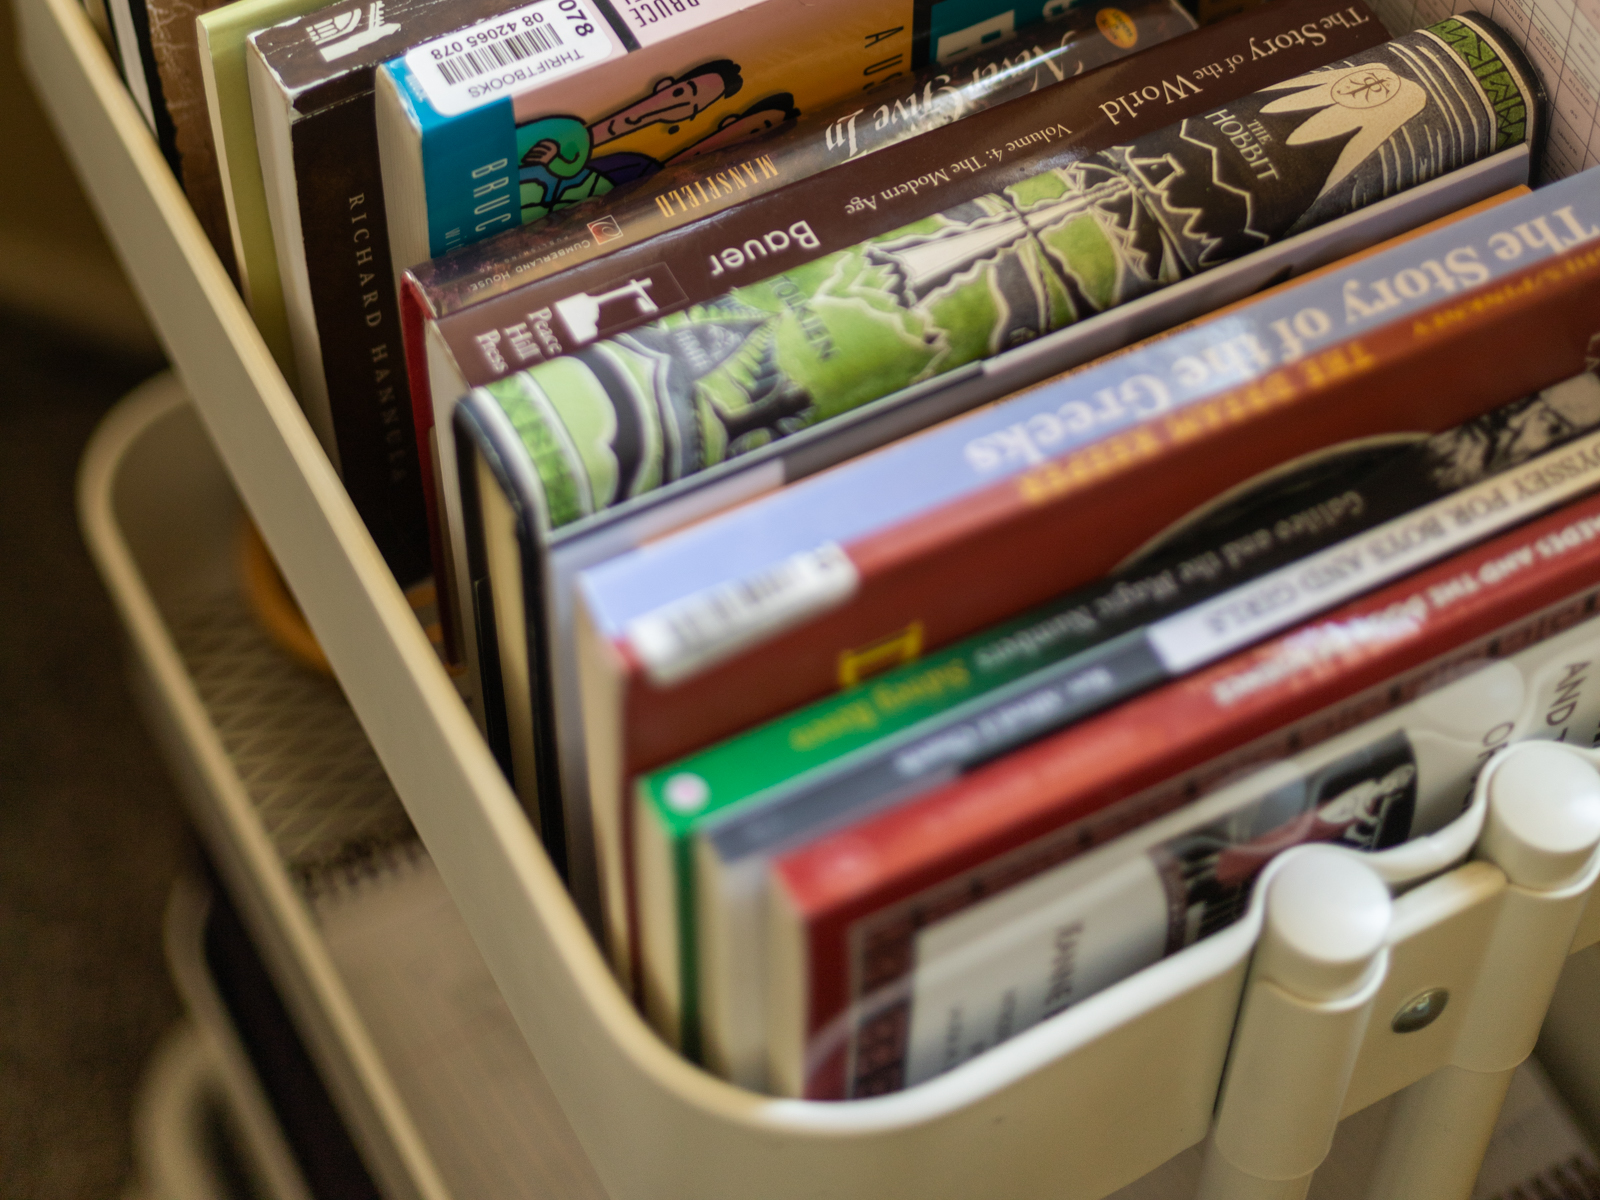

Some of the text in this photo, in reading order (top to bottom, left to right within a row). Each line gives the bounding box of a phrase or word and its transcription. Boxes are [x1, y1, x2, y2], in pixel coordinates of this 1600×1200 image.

[430, 12, 544, 61] 08 42065 078
[468, 47, 585, 99] THRIFTBOOKS
[874, 74, 973, 133] Give
[709, 6, 1370, 277] The Story of the World Volume 4: The Modern Age Bauer
[825, 108, 870, 160] In
[1205, 109, 1280, 181] HOBBIT
[1250, 118, 1273, 145] THE
[473, 158, 511, 232] BRUC
[655, 154, 780, 218] MANSFIELD
[349, 192, 383, 327] RICHARD
[1488, 205, 1600, 260] The
[467, 237, 592, 292] CUMBERLAND HOUSE
[1343, 244, 1490, 324] Story
[476, 332, 509, 372] Press
[505, 323, 539, 361] Hill
[527, 308, 562, 354] Peace
[1270, 307, 1332, 357] of
[963, 374, 1171, 475] Greeks
[1270, 485, 1367, 548] Galileo
[1443, 485, 1508, 530] FOR
[1220, 526, 1277, 569] and
[1364, 514, 1447, 569] BOYS
[1087, 561, 1179, 626] Magic
[1177, 550, 1224, 589] the
[1293, 549, 1368, 600] AND
[1424, 568, 1480, 608] THE
[1202, 580, 1300, 641] GIRLS
[970, 602, 1097, 678] Numbers
[1545, 660, 1590, 727] AND
